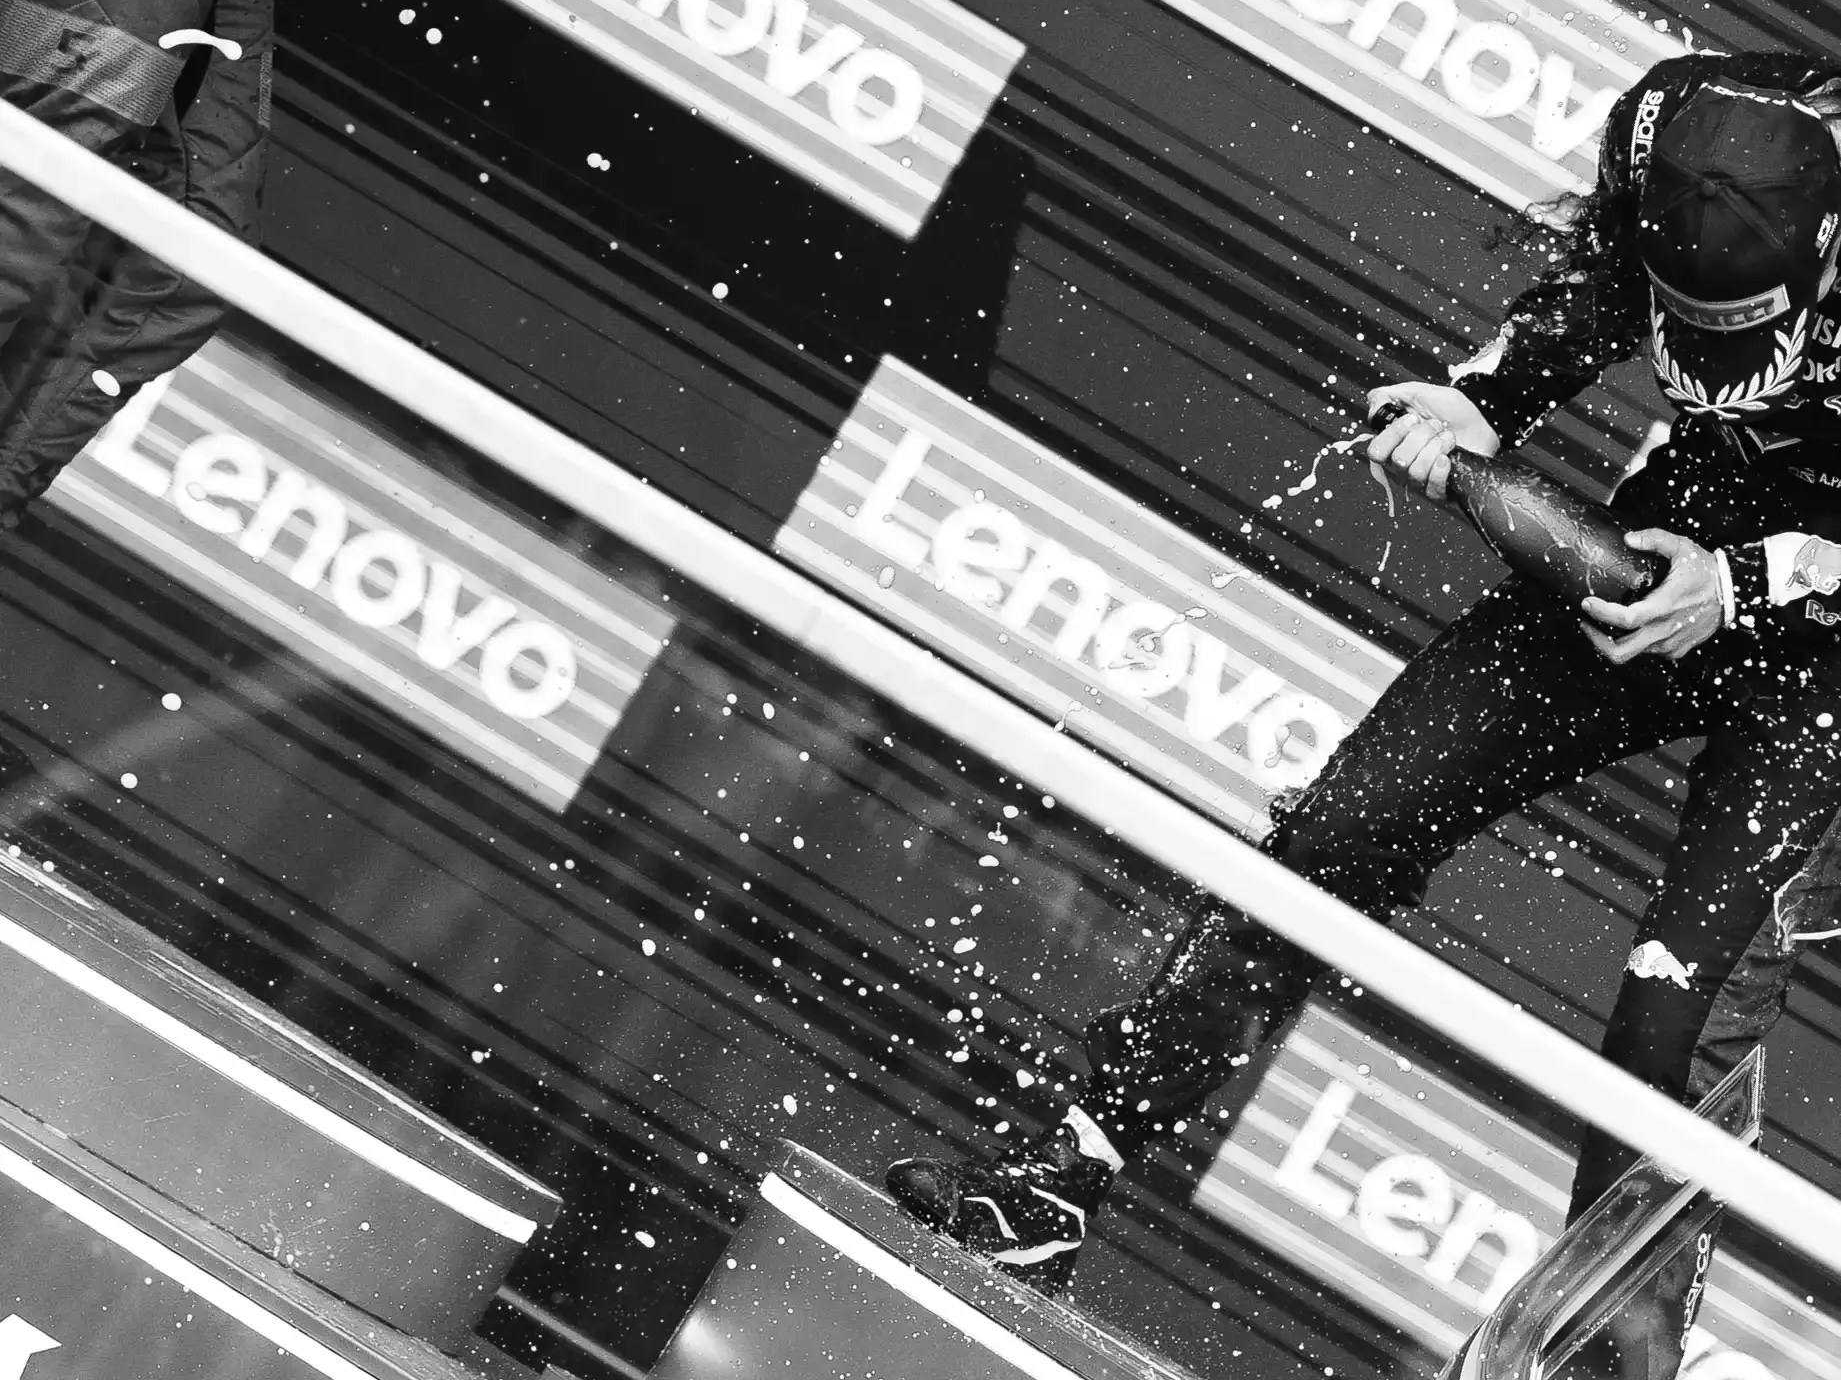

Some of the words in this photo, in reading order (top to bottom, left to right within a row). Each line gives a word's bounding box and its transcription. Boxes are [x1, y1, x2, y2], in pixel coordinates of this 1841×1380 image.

[92, 369, 578, 720] Lenovo
[855, 428, 1348, 789] Lenovo
[1273, 1078, 1539, 1318] Len
